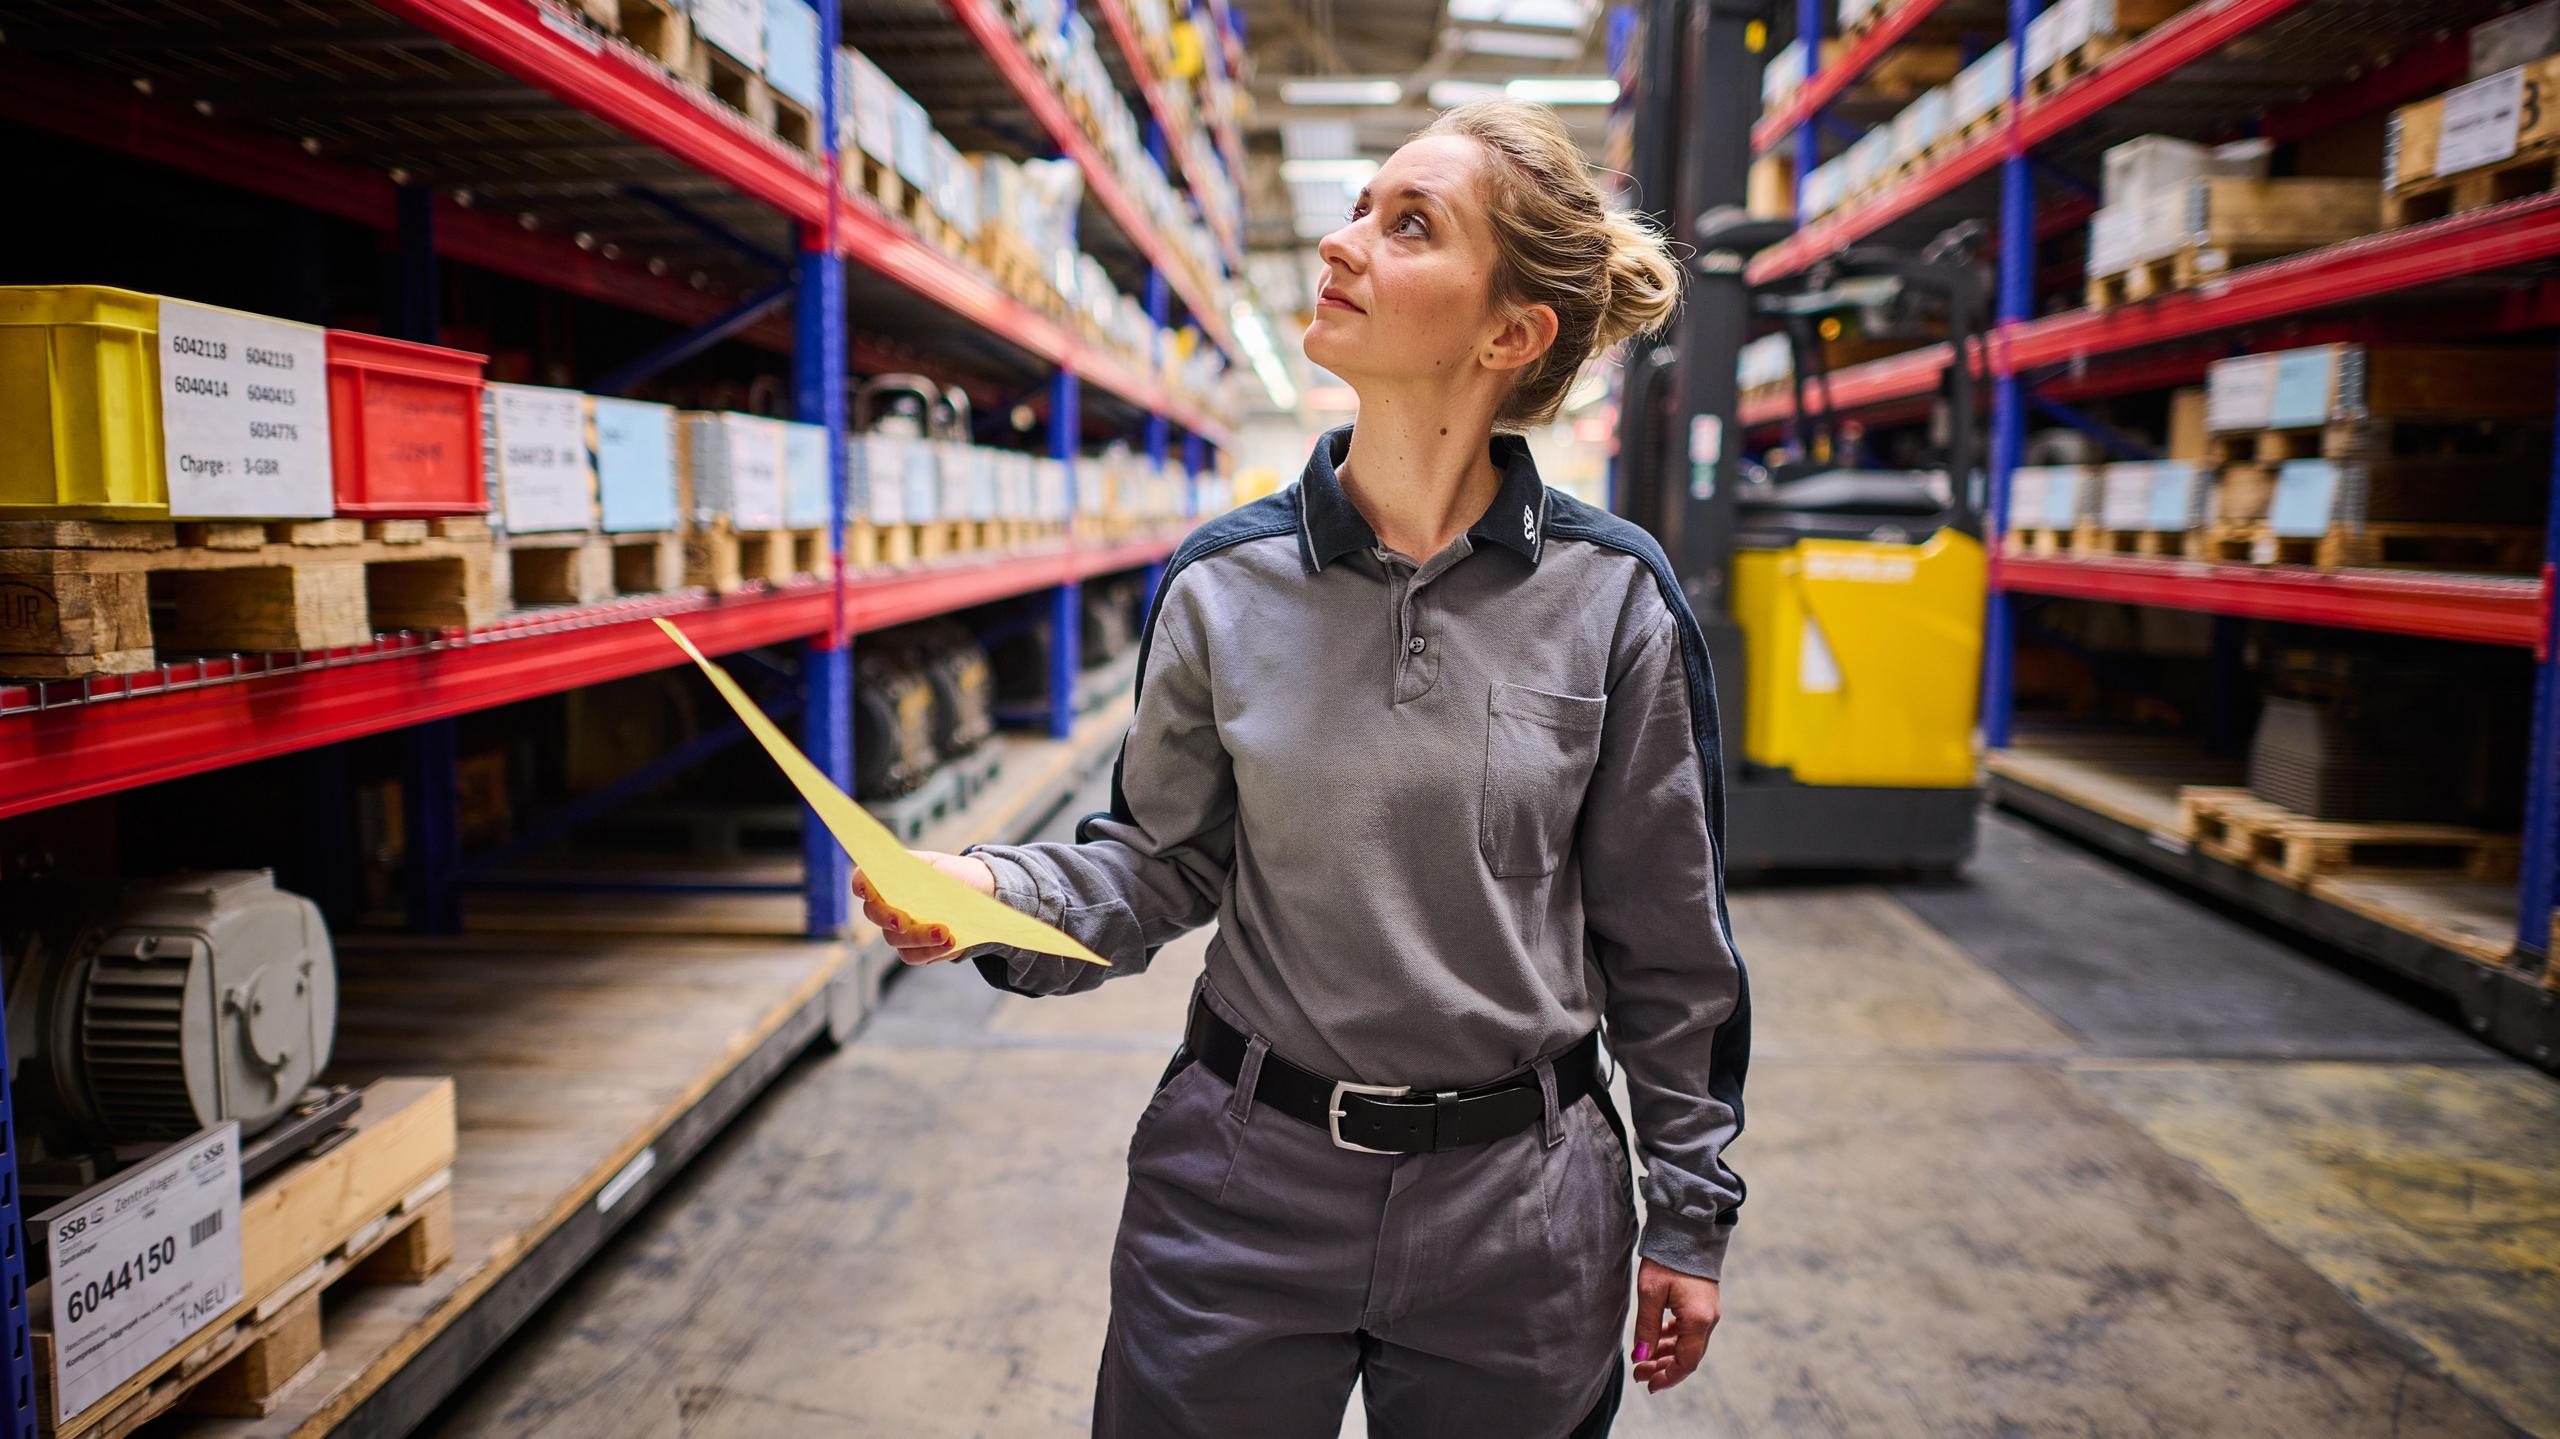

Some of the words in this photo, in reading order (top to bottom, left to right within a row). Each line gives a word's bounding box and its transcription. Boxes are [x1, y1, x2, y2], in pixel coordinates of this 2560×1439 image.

[173, 336, 227, 360] 6042118
[246, 348, 294, 370] 6042119
[175, 376, 228, 397] 6040414
[247, 384, 296, 406] 6040415
[249, 421, 298, 441] 6034776
[243, 458, 279, 475] 3-GBR
[3, 592, 40, 631] UR
[60, 1216, 87, 1243] SSB
[114, 1170, 178, 1213] Zentrallager
[68, 1236, 176, 1323] 6044150
[179, 1282, 226, 1328] 1-NEU
